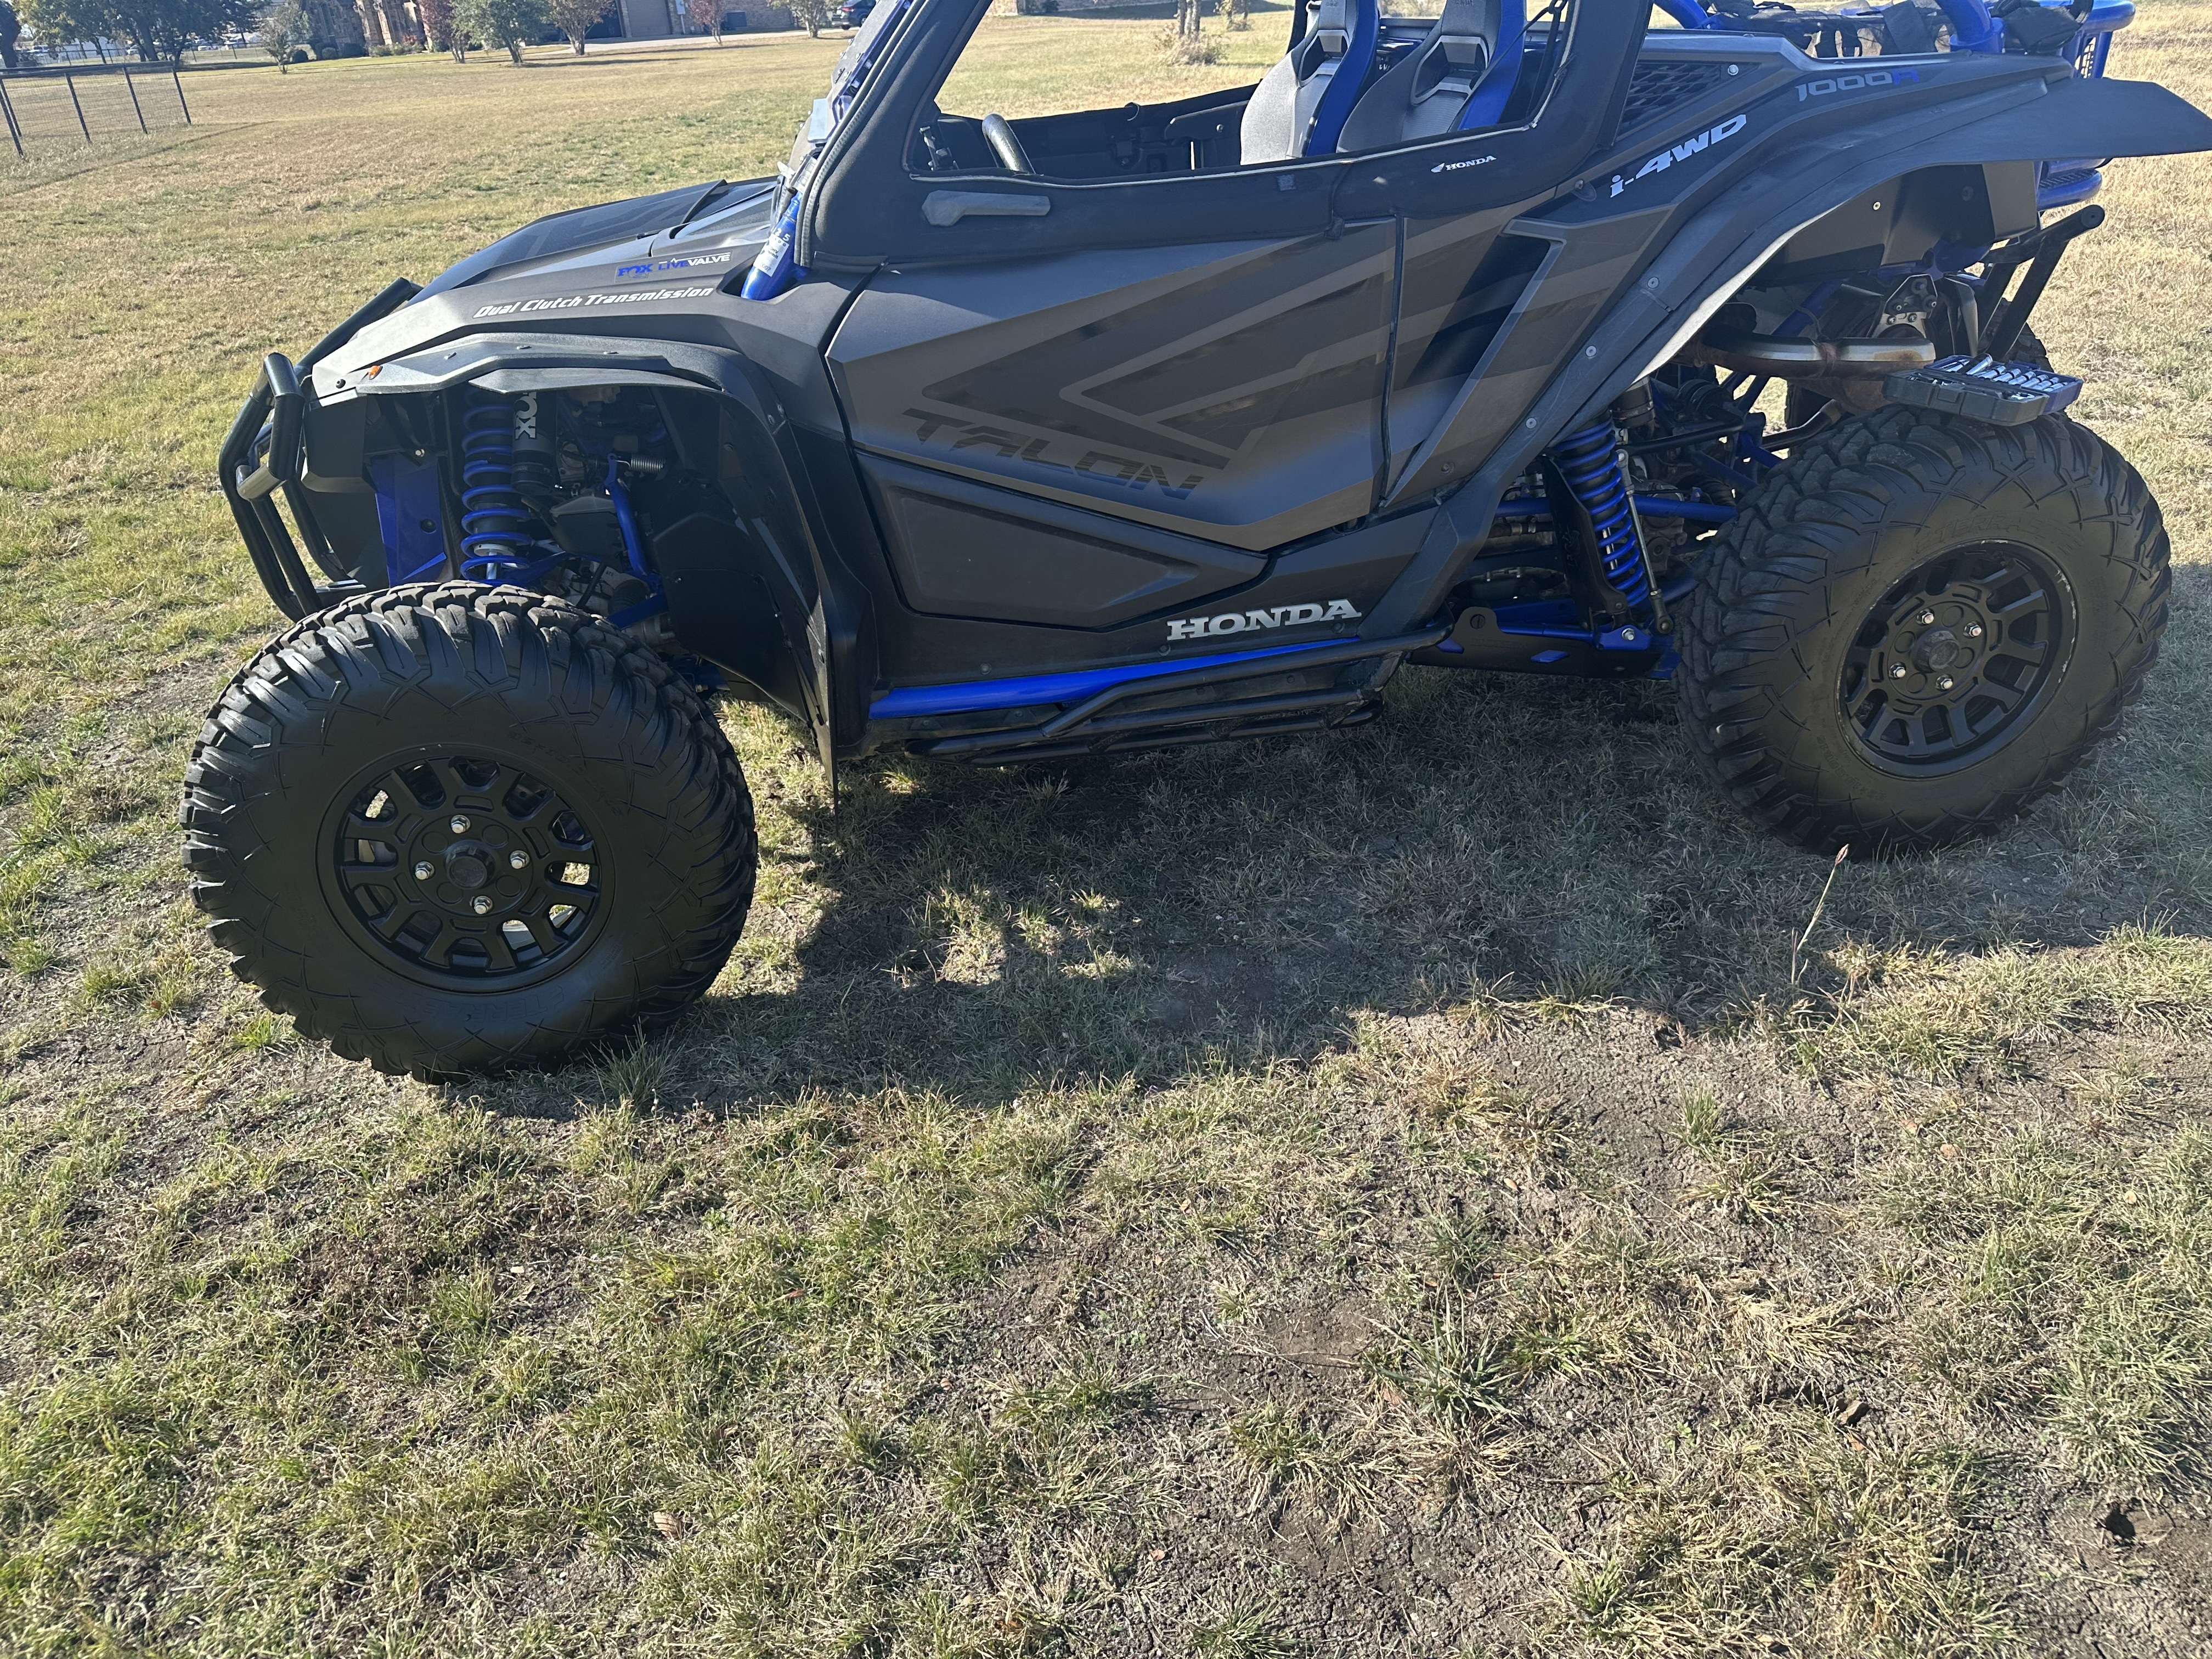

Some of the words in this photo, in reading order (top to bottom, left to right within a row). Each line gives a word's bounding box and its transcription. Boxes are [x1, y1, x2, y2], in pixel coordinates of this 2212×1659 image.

[1795, 67, 1920, 102] 1000R
[1445, 155, 1497, 171] HONDA
[1610, 114, 1747, 198] i-4WD
[617, 263, 653, 278] FOX
[473, 302, 521, 318] Dual
[520, 296, 582, 312] Clutch
[584, 287, 714, 306] Transmission
[515, 391, 538, 439] OX
[901, 408, 1204, 500] TALON
[1166, 599, 1362, 641] HONDA
